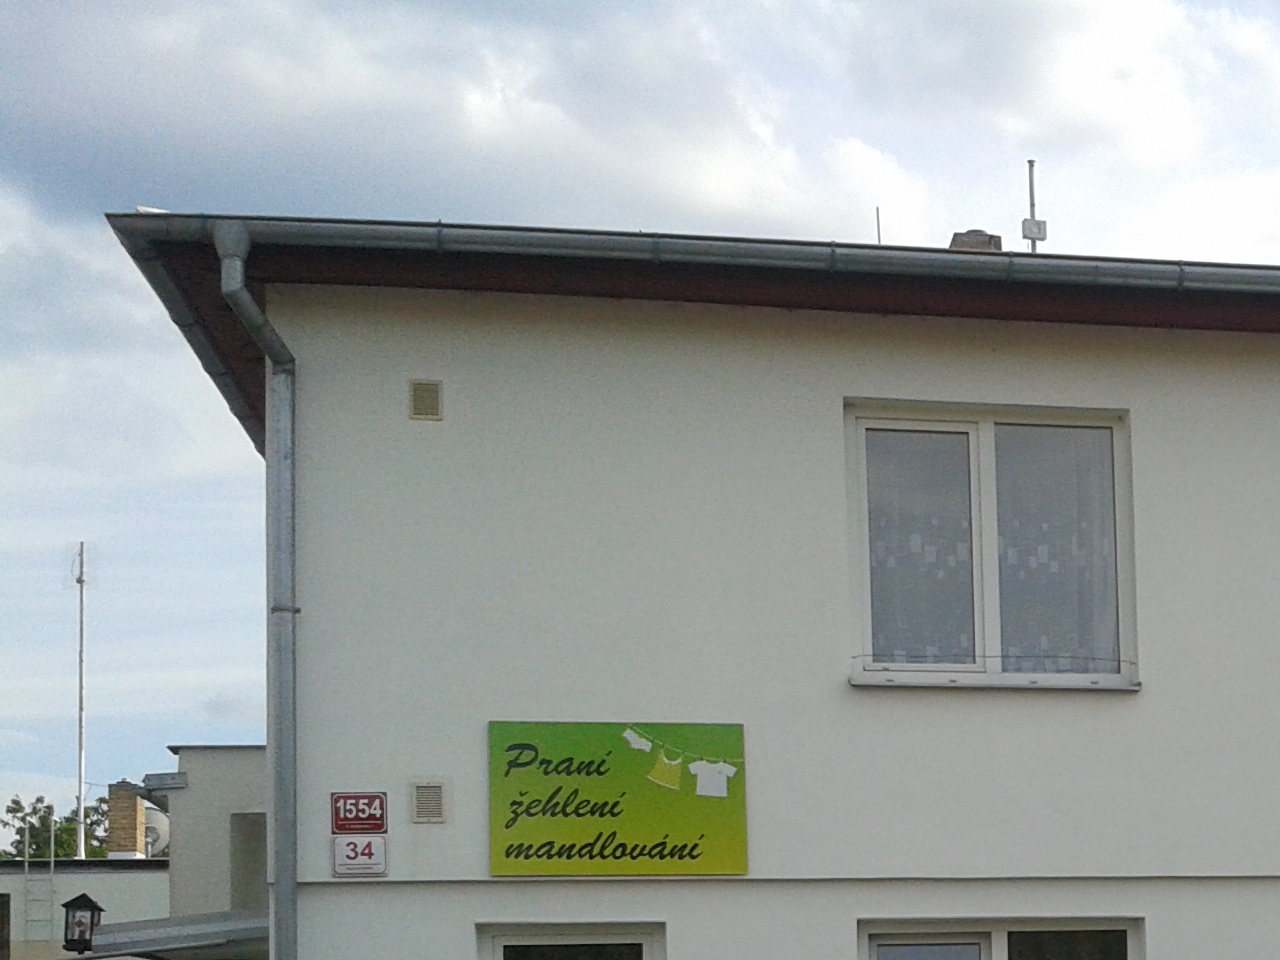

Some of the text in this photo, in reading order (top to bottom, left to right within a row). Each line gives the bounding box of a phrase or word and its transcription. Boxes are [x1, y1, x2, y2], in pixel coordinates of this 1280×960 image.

[504, 743, 612, 778] Praní
[336, 798, 382, 819] 1554
[504, 786, 626, 830] žehlení
[345, 841, 375, 861] 34
[504, 831, 705, 861] mandlování
